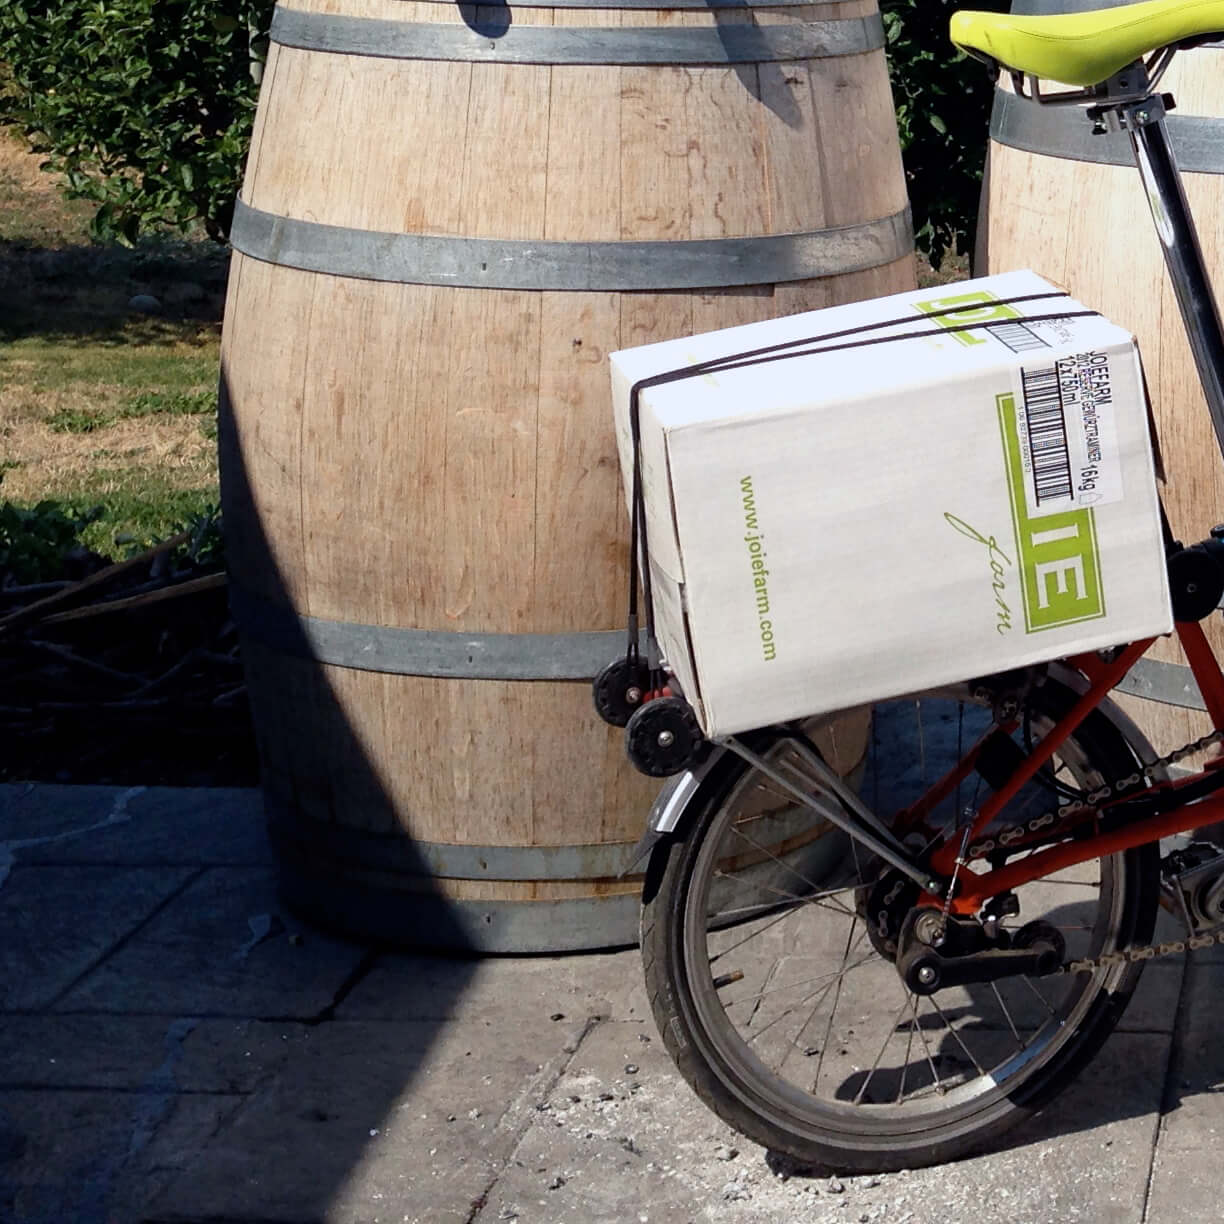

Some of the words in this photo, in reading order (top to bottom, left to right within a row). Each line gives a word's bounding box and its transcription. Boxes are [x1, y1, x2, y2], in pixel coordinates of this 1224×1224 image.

[1076, 353, 1090, 368] 2012
[1089, 351, 1113, 405] JOIEFARM
[739, 475, 777, 662] www.joiefarm.com
[943, 511, 1012, 635] farm
